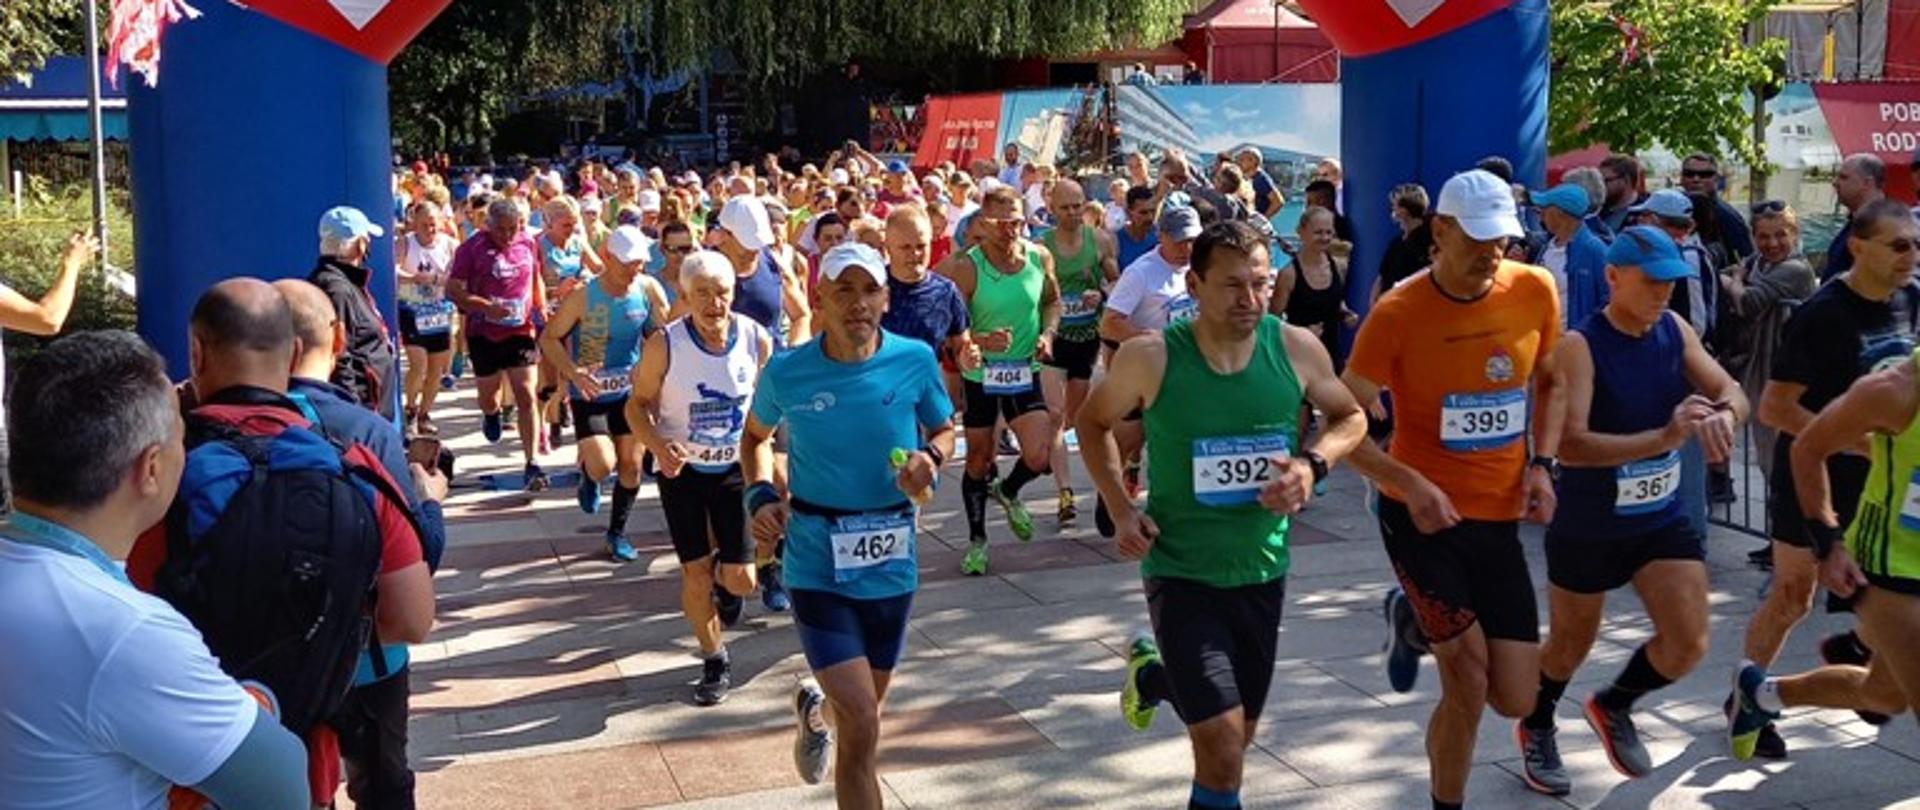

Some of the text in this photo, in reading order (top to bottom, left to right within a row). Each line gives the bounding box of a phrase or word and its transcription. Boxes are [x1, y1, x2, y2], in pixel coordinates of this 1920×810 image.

[1880, 102, 1920, 122] POB
[1872, 132, 1920, 152] ROD
[994, 369, 1021, 384] 404
[1461, 409, 1509, 434] 399
[699, 446, 736, 463] 449
[1217, 456, 1270, 485] 392
[1635, 472, 1673, 500] 367
[853, 532, 896, 560] 462
